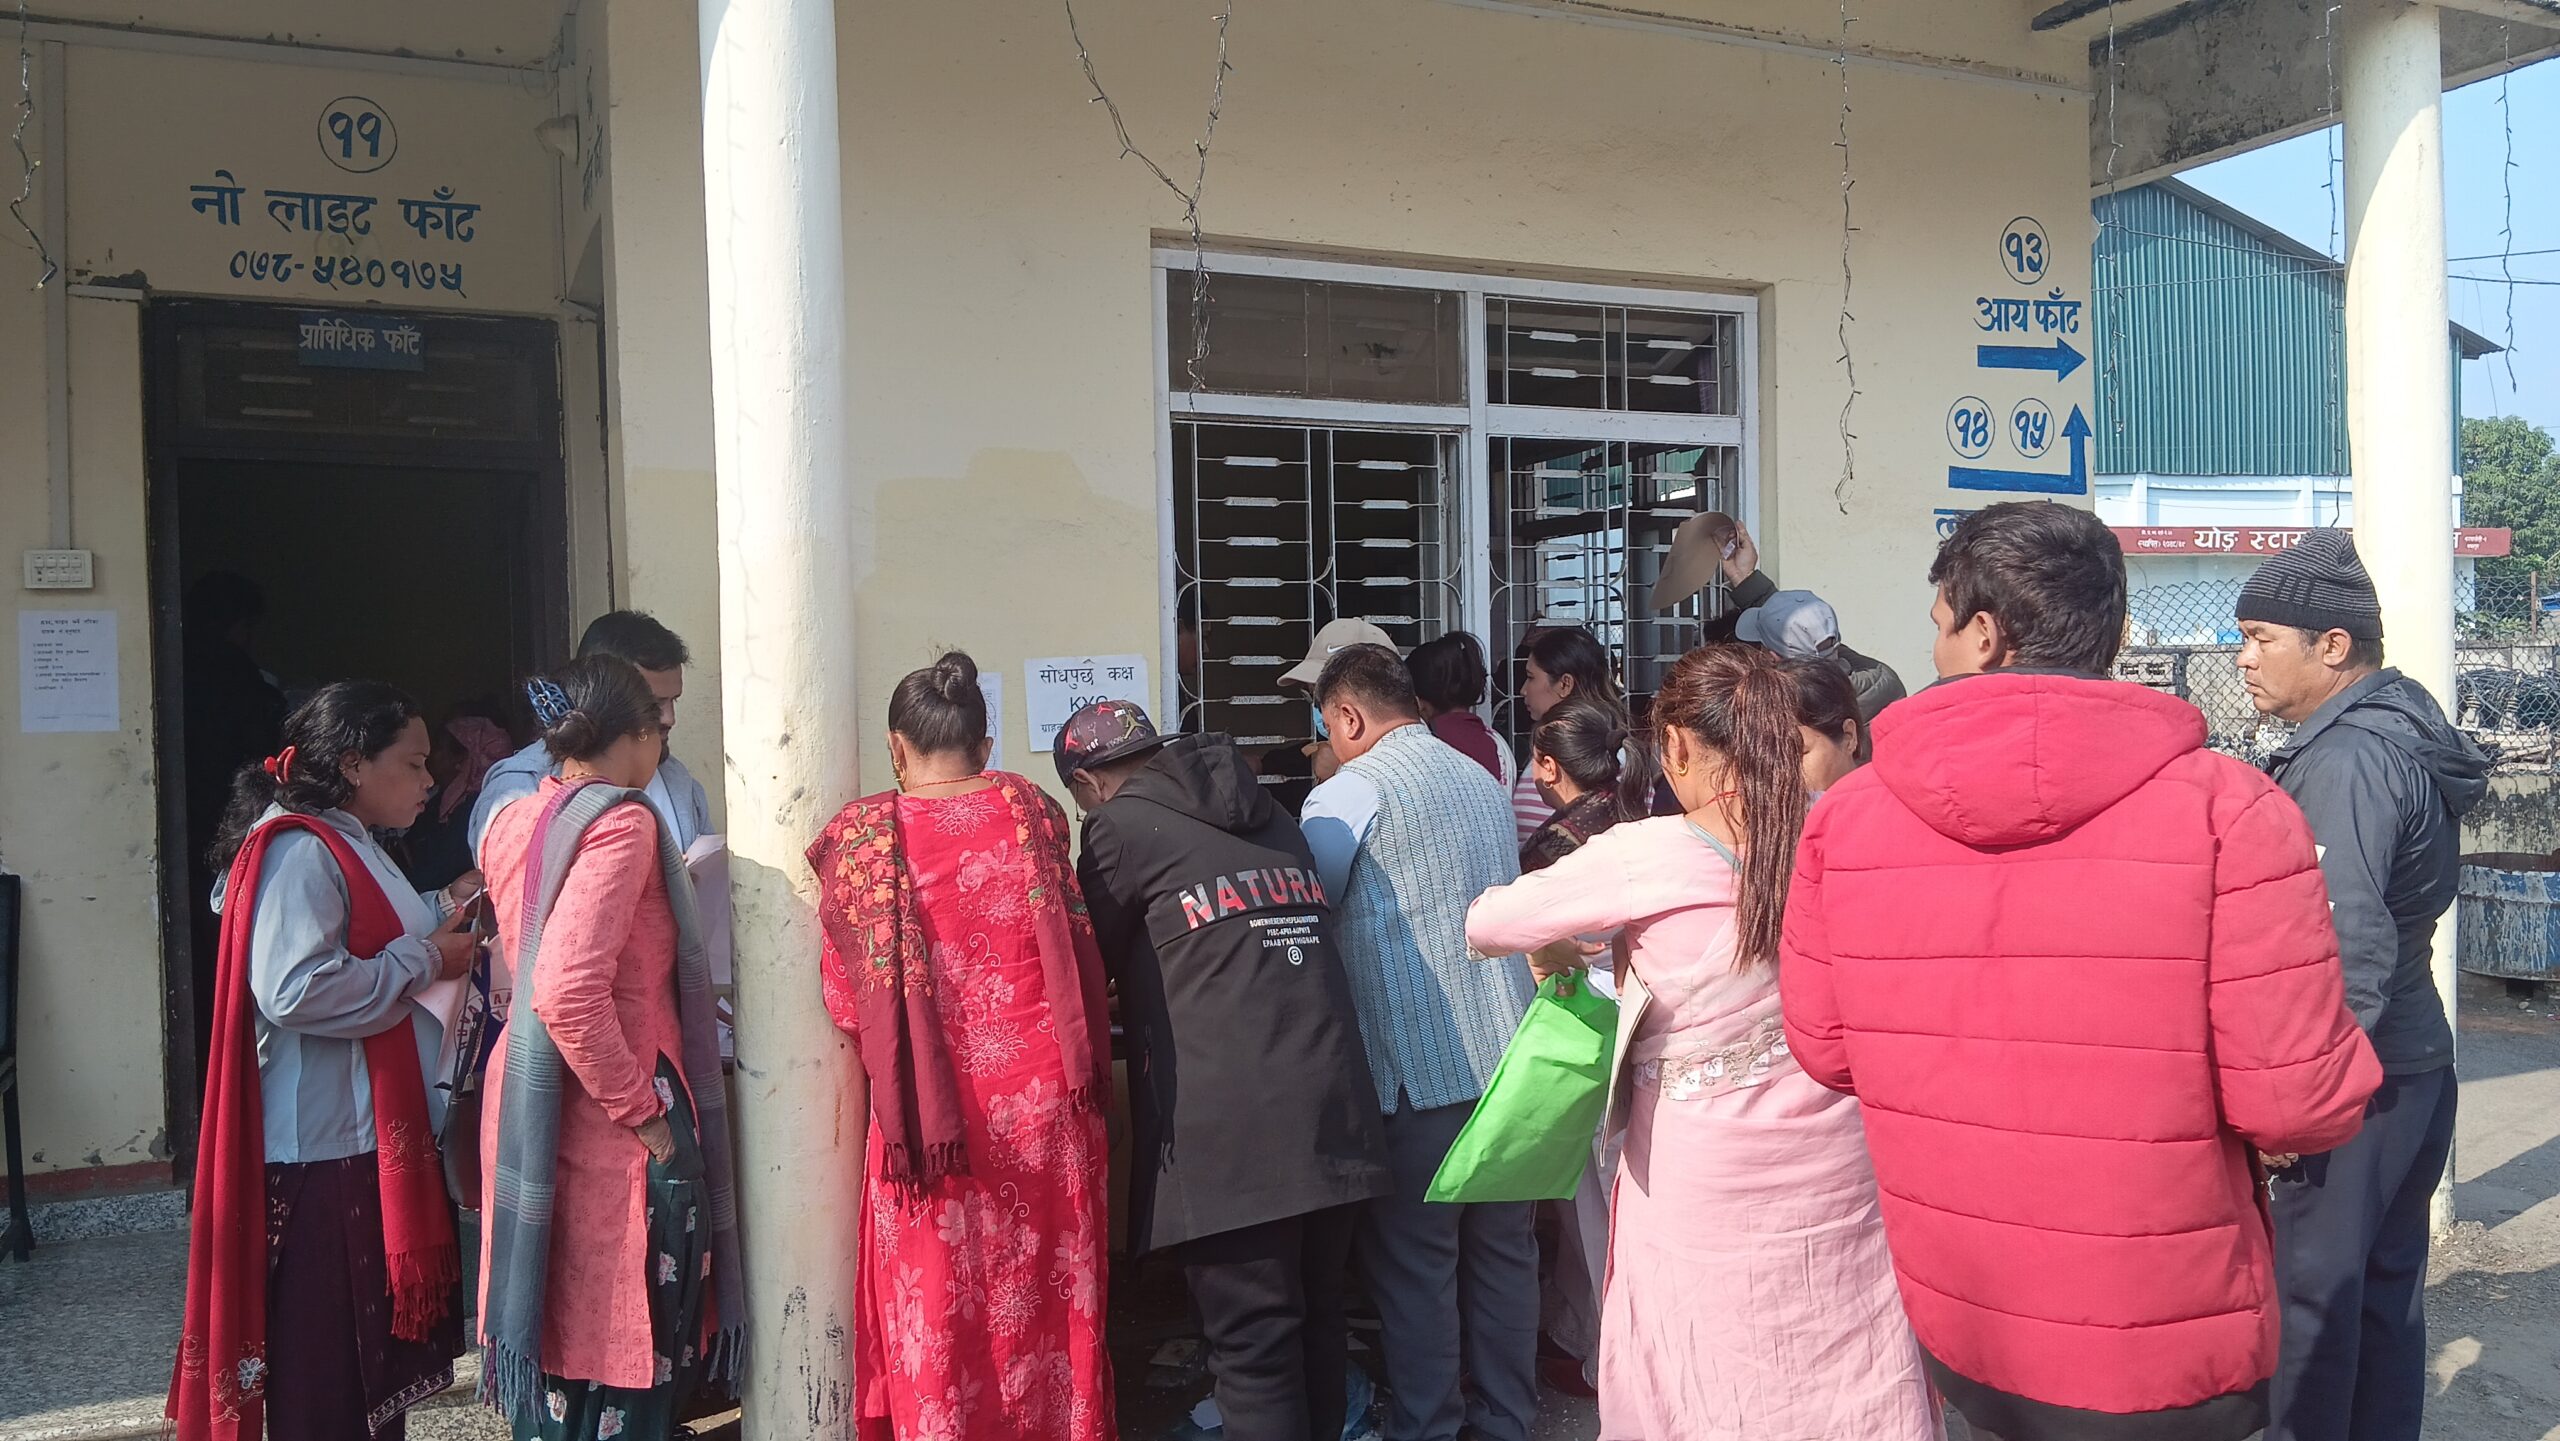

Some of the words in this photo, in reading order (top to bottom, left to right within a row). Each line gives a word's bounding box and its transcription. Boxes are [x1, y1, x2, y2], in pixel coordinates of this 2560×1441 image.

[328, 111, 382, 158] ११
[190, 169, 246, 225] नो
[264, 189, 378, 245] लाइट
[397, 185, 481, 243] फाँट
[2005, 232, 2043, 275] १३
[1973, 296, 2030, 332] आय
[2033, 286, 2082, 334] फाँट
[382, 324, 421, 355] फाँट
[1954, 407, 1989, 449] १४
[2014, 409, 2048, 450] १५
[1107, 666, 1135, 681] कक्ष
[1178, 867, 1329, 930] NATURA
